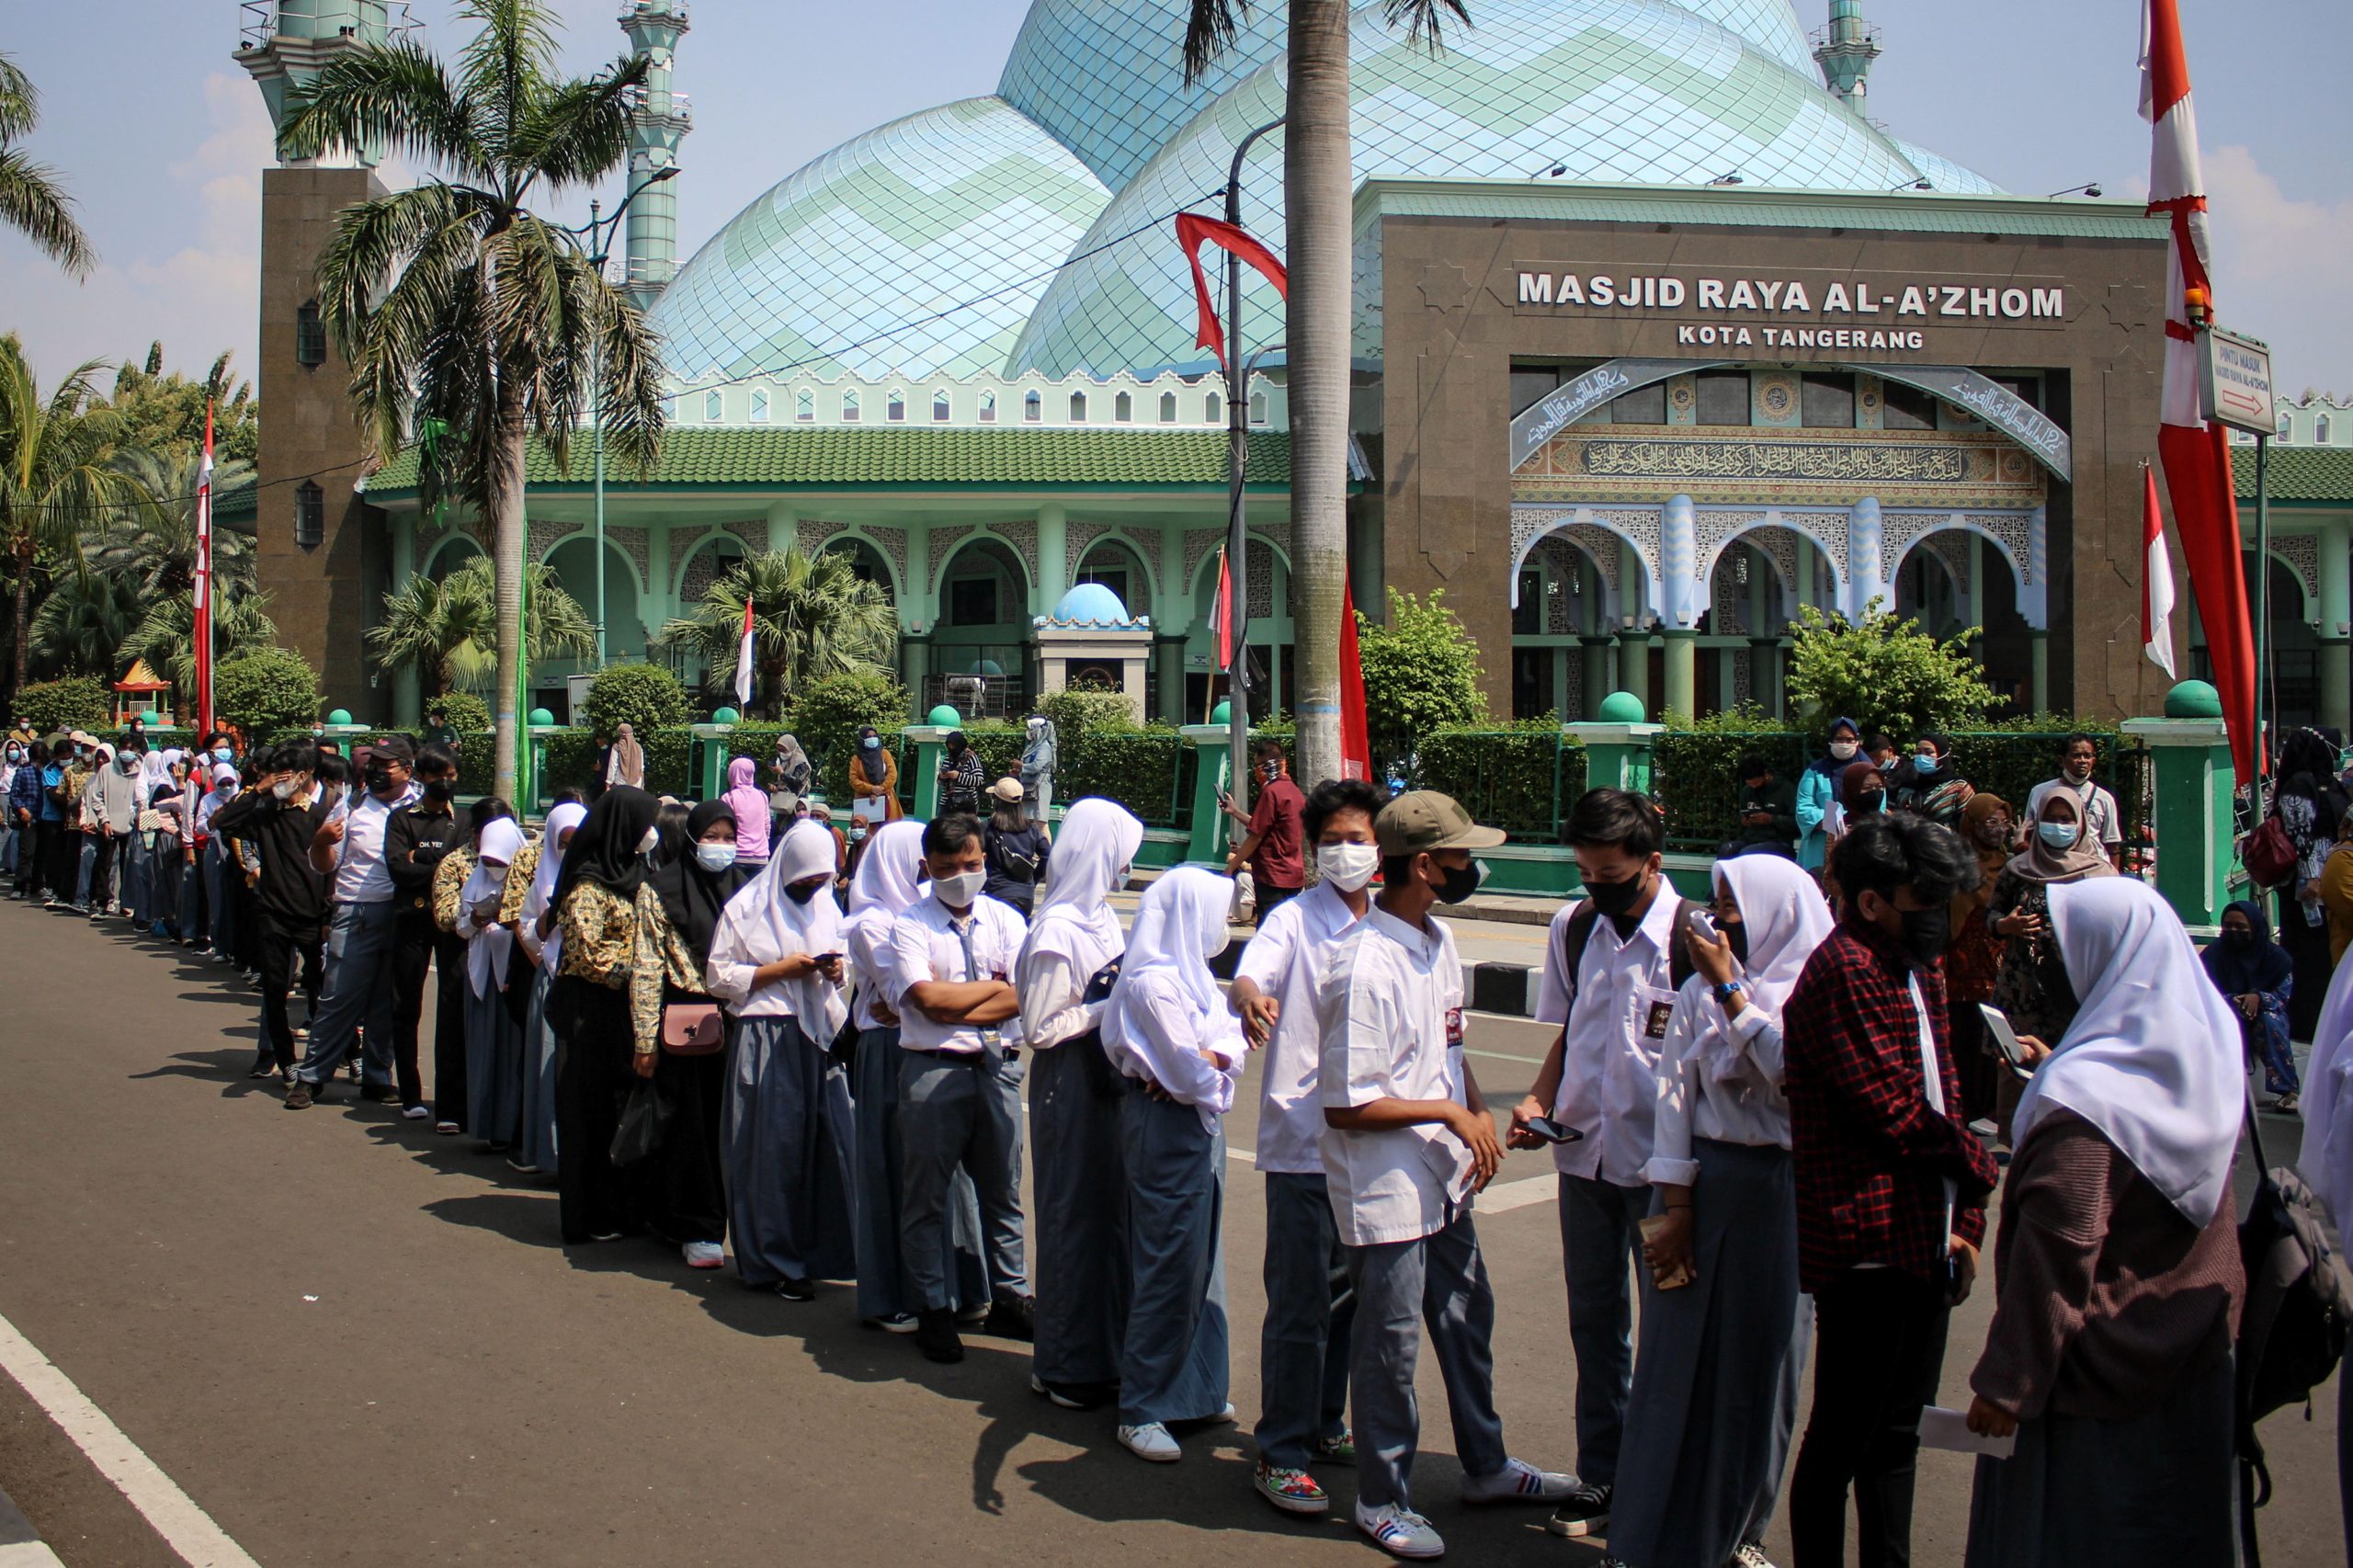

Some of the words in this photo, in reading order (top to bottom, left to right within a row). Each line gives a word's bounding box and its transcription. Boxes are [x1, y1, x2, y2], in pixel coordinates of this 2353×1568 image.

[1518, 273, 1686, 309] MASJID
[1698, 278, 1811, 311] RAYA
[1823, 282, 2063, 318] AL-A'ZHOM
[1678, 325, 1753, 346] KOTA
[1762, 328, 1924, 349] TANGERANG
[2220, 346, 2239, 366] PINTU
[2239, 353, 2260, 373] MASUK
